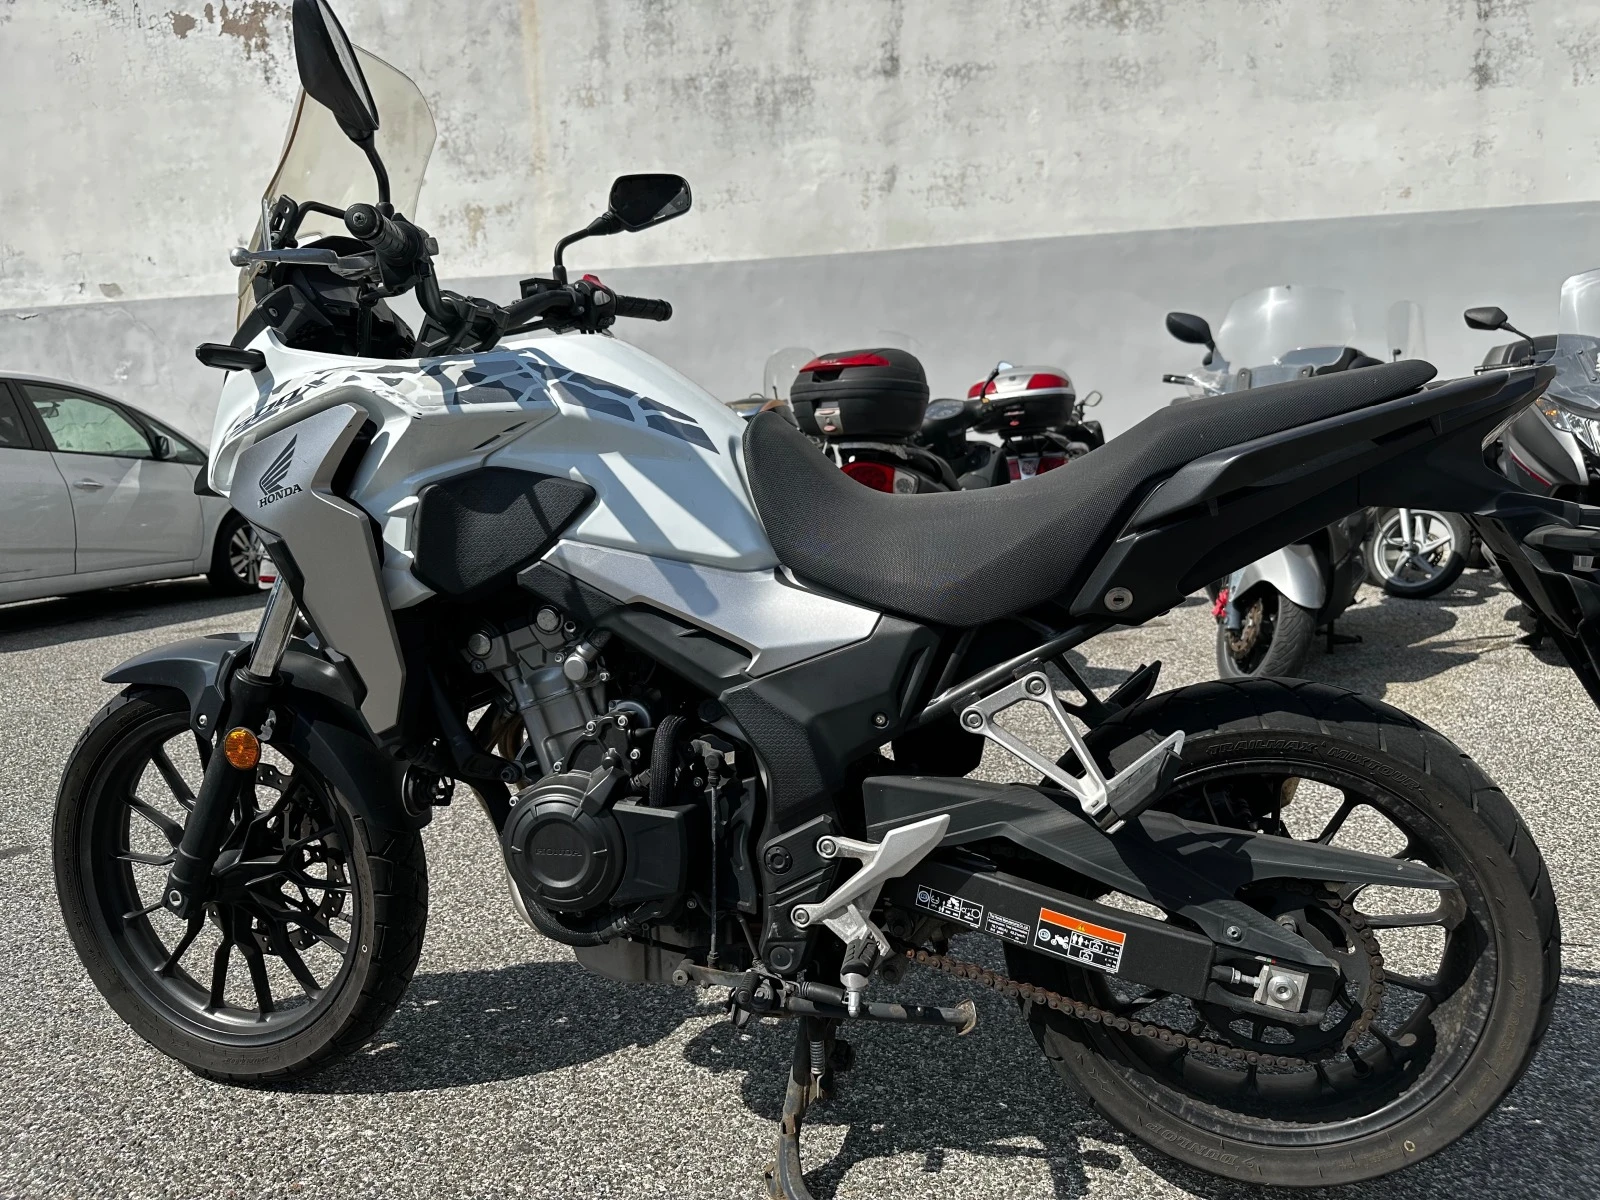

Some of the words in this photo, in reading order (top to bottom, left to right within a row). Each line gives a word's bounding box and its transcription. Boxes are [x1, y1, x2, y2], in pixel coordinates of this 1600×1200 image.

[259, 484, 302, 508] HONDA
[1208, 739, 1318, 755] TRAILMAX
[1327, 747, 1422, 791] MIXTOUR
[536, 848, 582, 857] HONDA
[1144, 1121, 1239, 1166] DUNLOP
